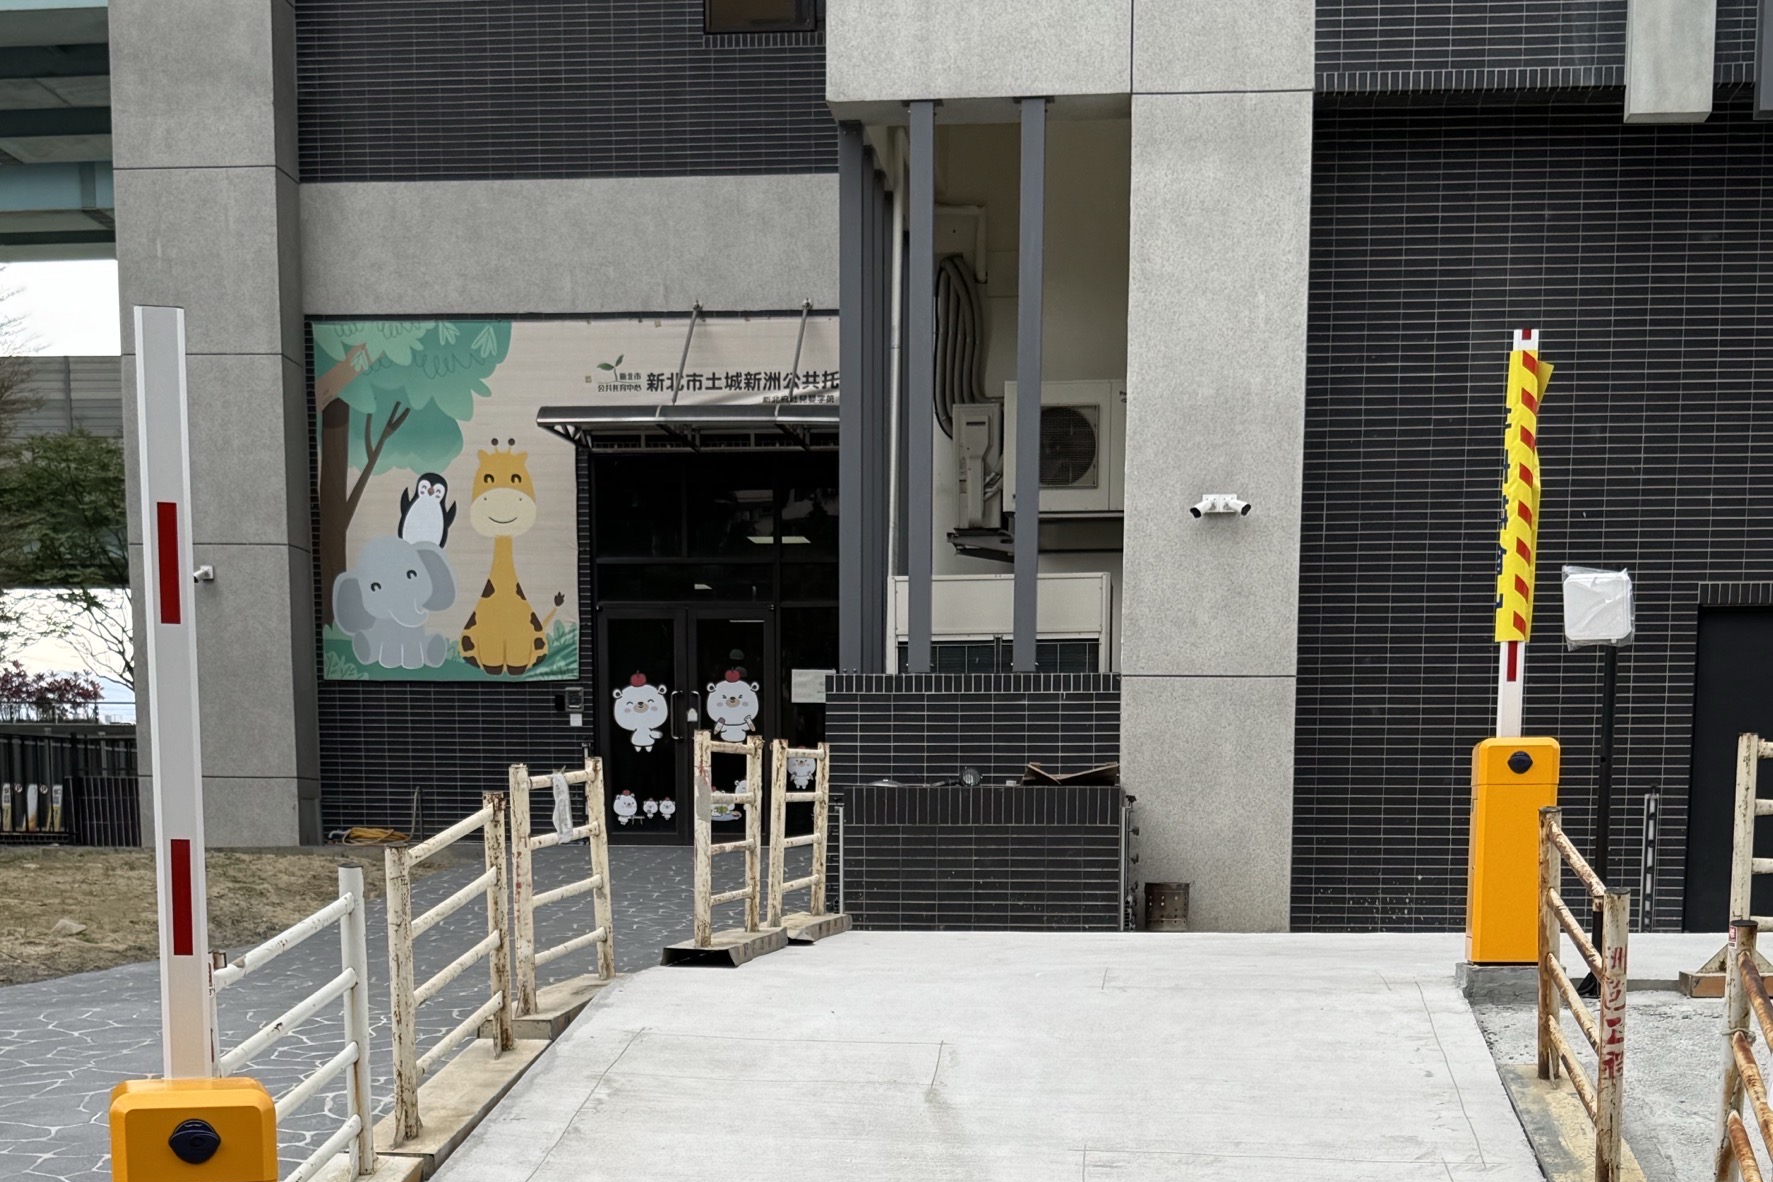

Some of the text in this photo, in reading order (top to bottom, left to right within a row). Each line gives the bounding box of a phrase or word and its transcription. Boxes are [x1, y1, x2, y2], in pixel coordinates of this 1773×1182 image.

[646, 370, 840, 392] 新北市土城新洲公共托
